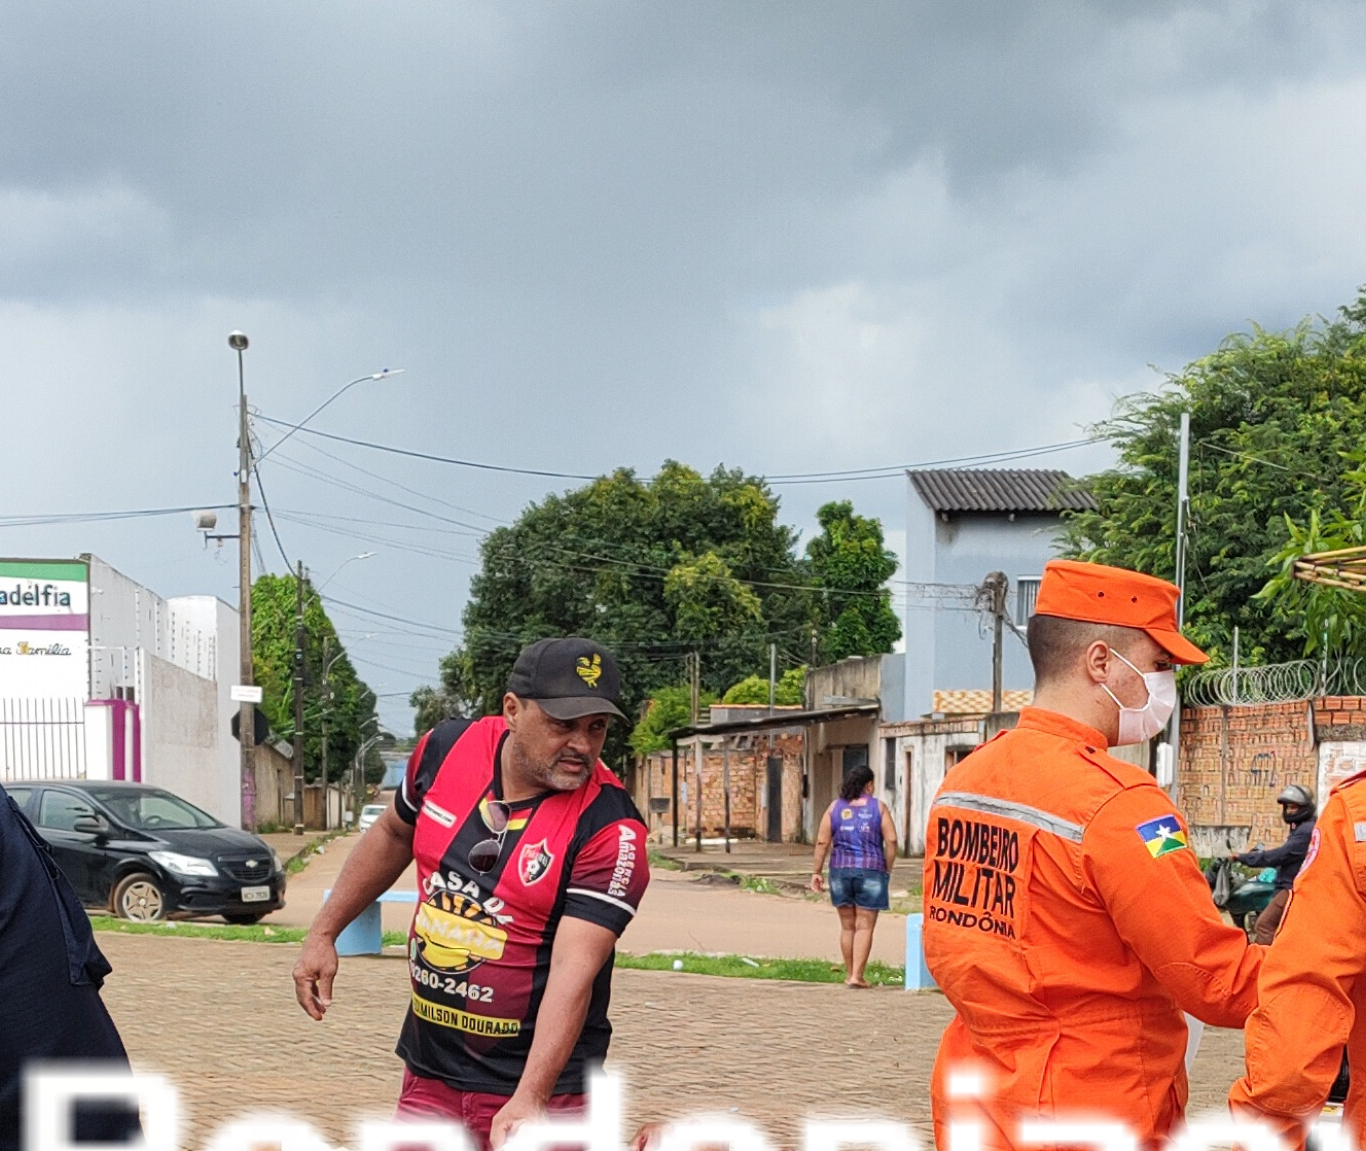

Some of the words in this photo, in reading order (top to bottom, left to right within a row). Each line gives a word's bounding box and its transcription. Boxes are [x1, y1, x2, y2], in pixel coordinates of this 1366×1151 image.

[936, 817, 1019, 874] BOMBEIRO
[422, 870, 480, 898] CASA
[932, 859, 1016, 919] MILITAR
[929, 905, 1017, 940] RONDÔNIA
